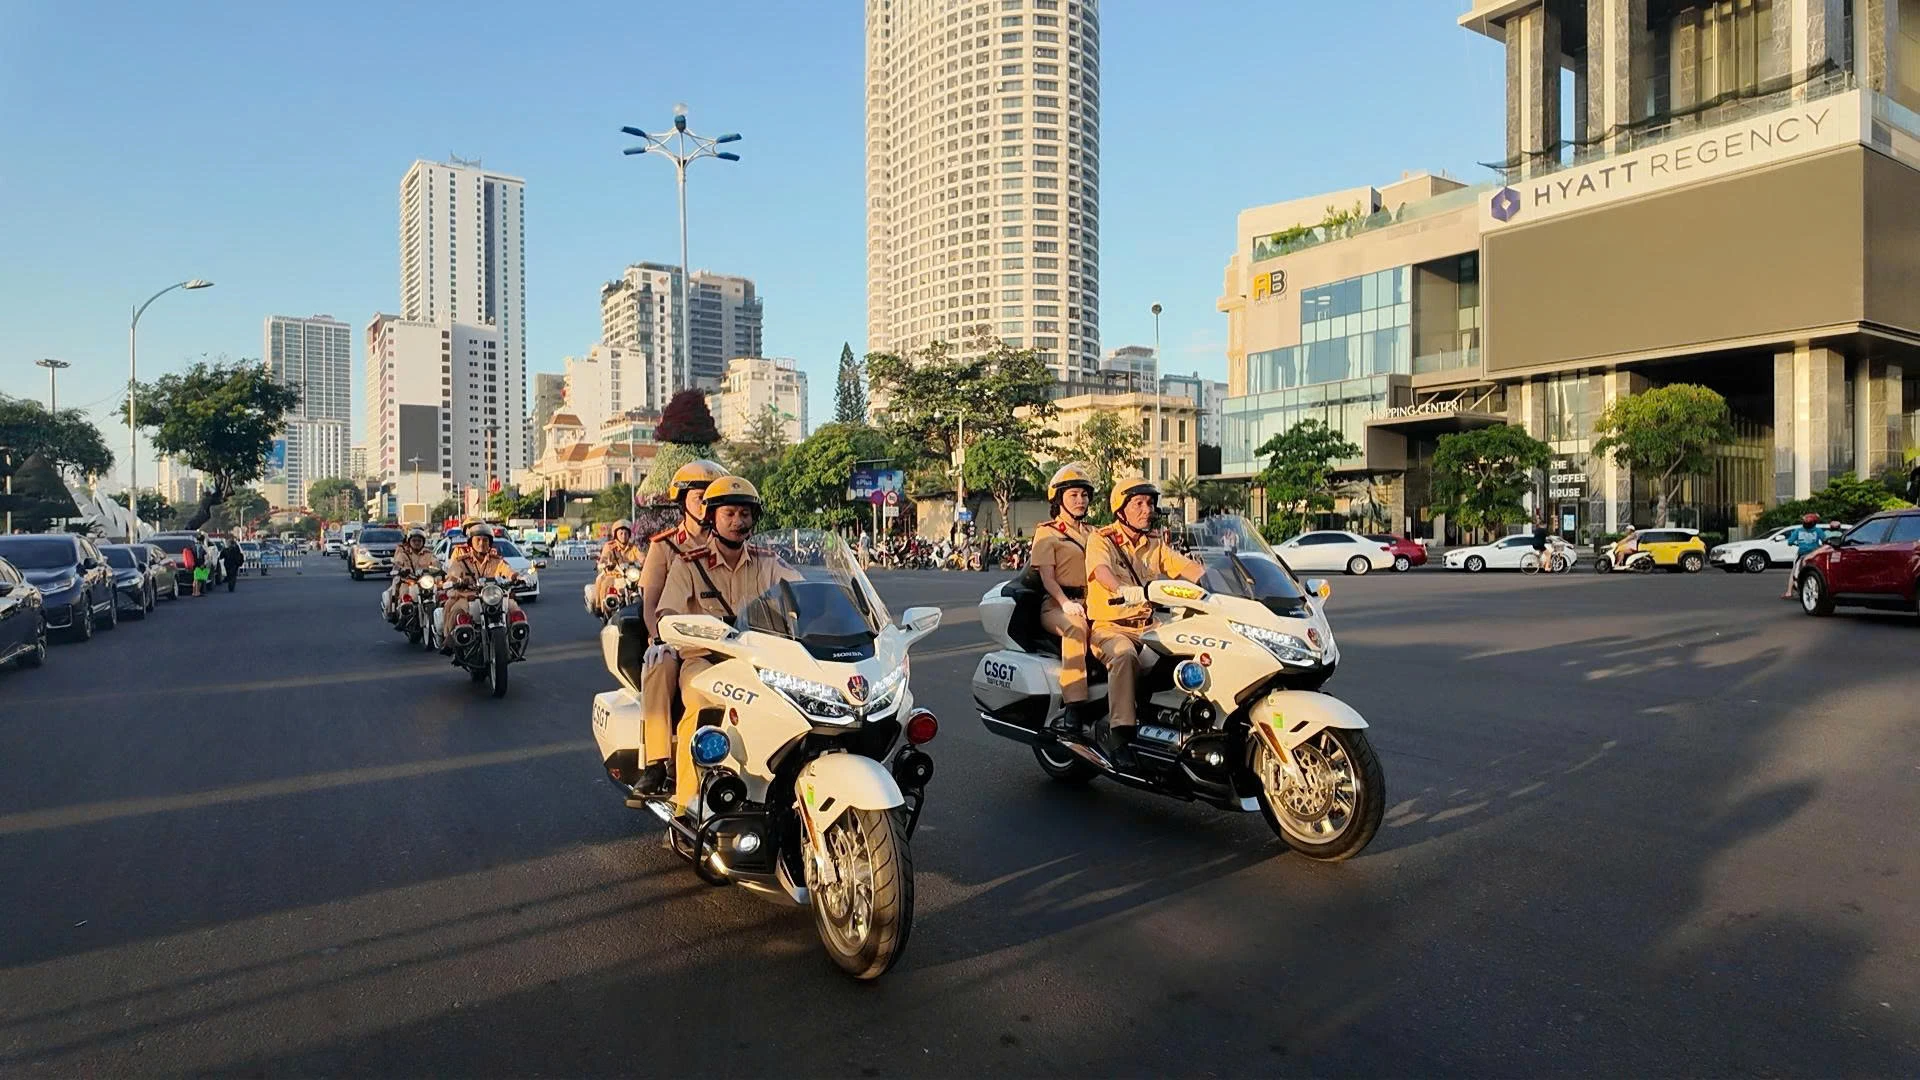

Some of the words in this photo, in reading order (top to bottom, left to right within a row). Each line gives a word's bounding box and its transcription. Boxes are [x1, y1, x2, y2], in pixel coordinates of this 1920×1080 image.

[1534, 161, 1638, 207] HYATT
[1650, 108, 1830, 176] REGENCY
[1368, 404, 1415, 419] OPPING
[1417, 400, 1459, 414] CENTER
[1551, 460, 1567, 469] THE
[1550, 474, 1586, 483] COFFEE
[1550, 488, 1580, 498] HOUSE
